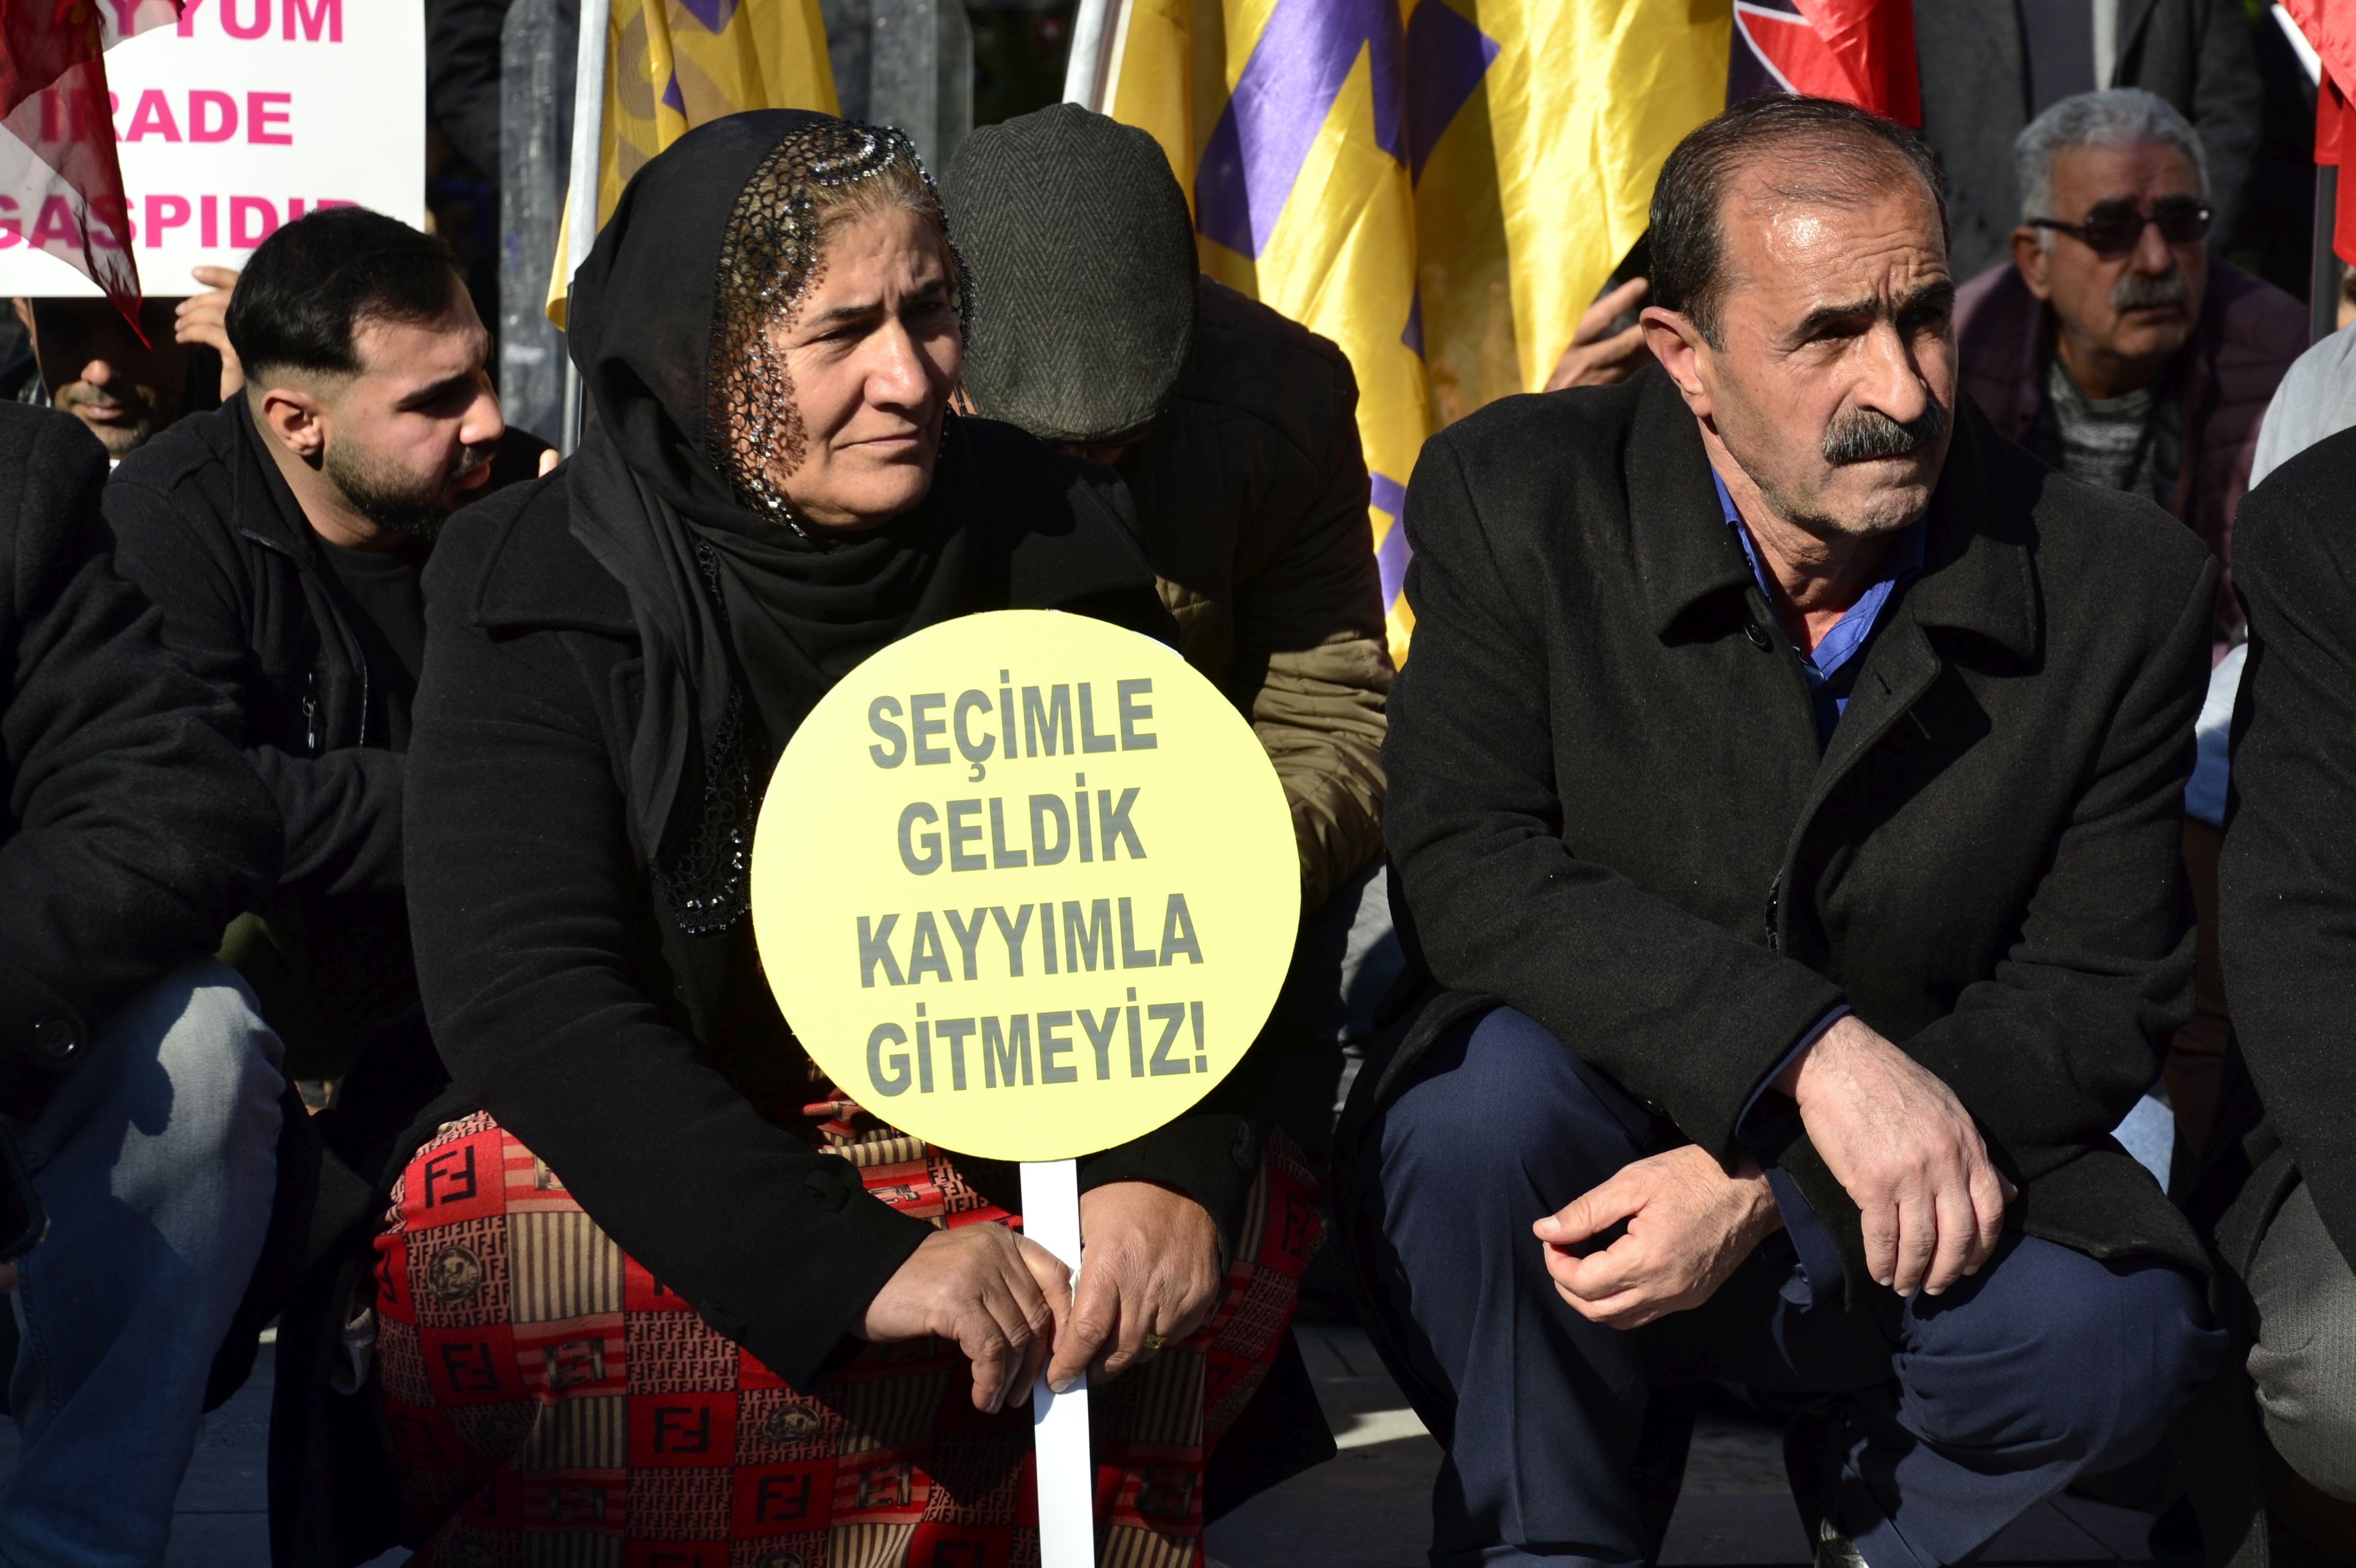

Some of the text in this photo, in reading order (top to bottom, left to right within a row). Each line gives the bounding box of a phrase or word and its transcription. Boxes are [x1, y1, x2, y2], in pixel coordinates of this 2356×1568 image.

[104, 0, 343, 43] YYUM
[868, 669, 1158, 783] SEÇİMLE
[898, 772, 1147, 876] GELDİK
[856, 893, 1204, 988] KAYYIMLA
[866, 987, 1208, 1097] GİTMEYİZ!
